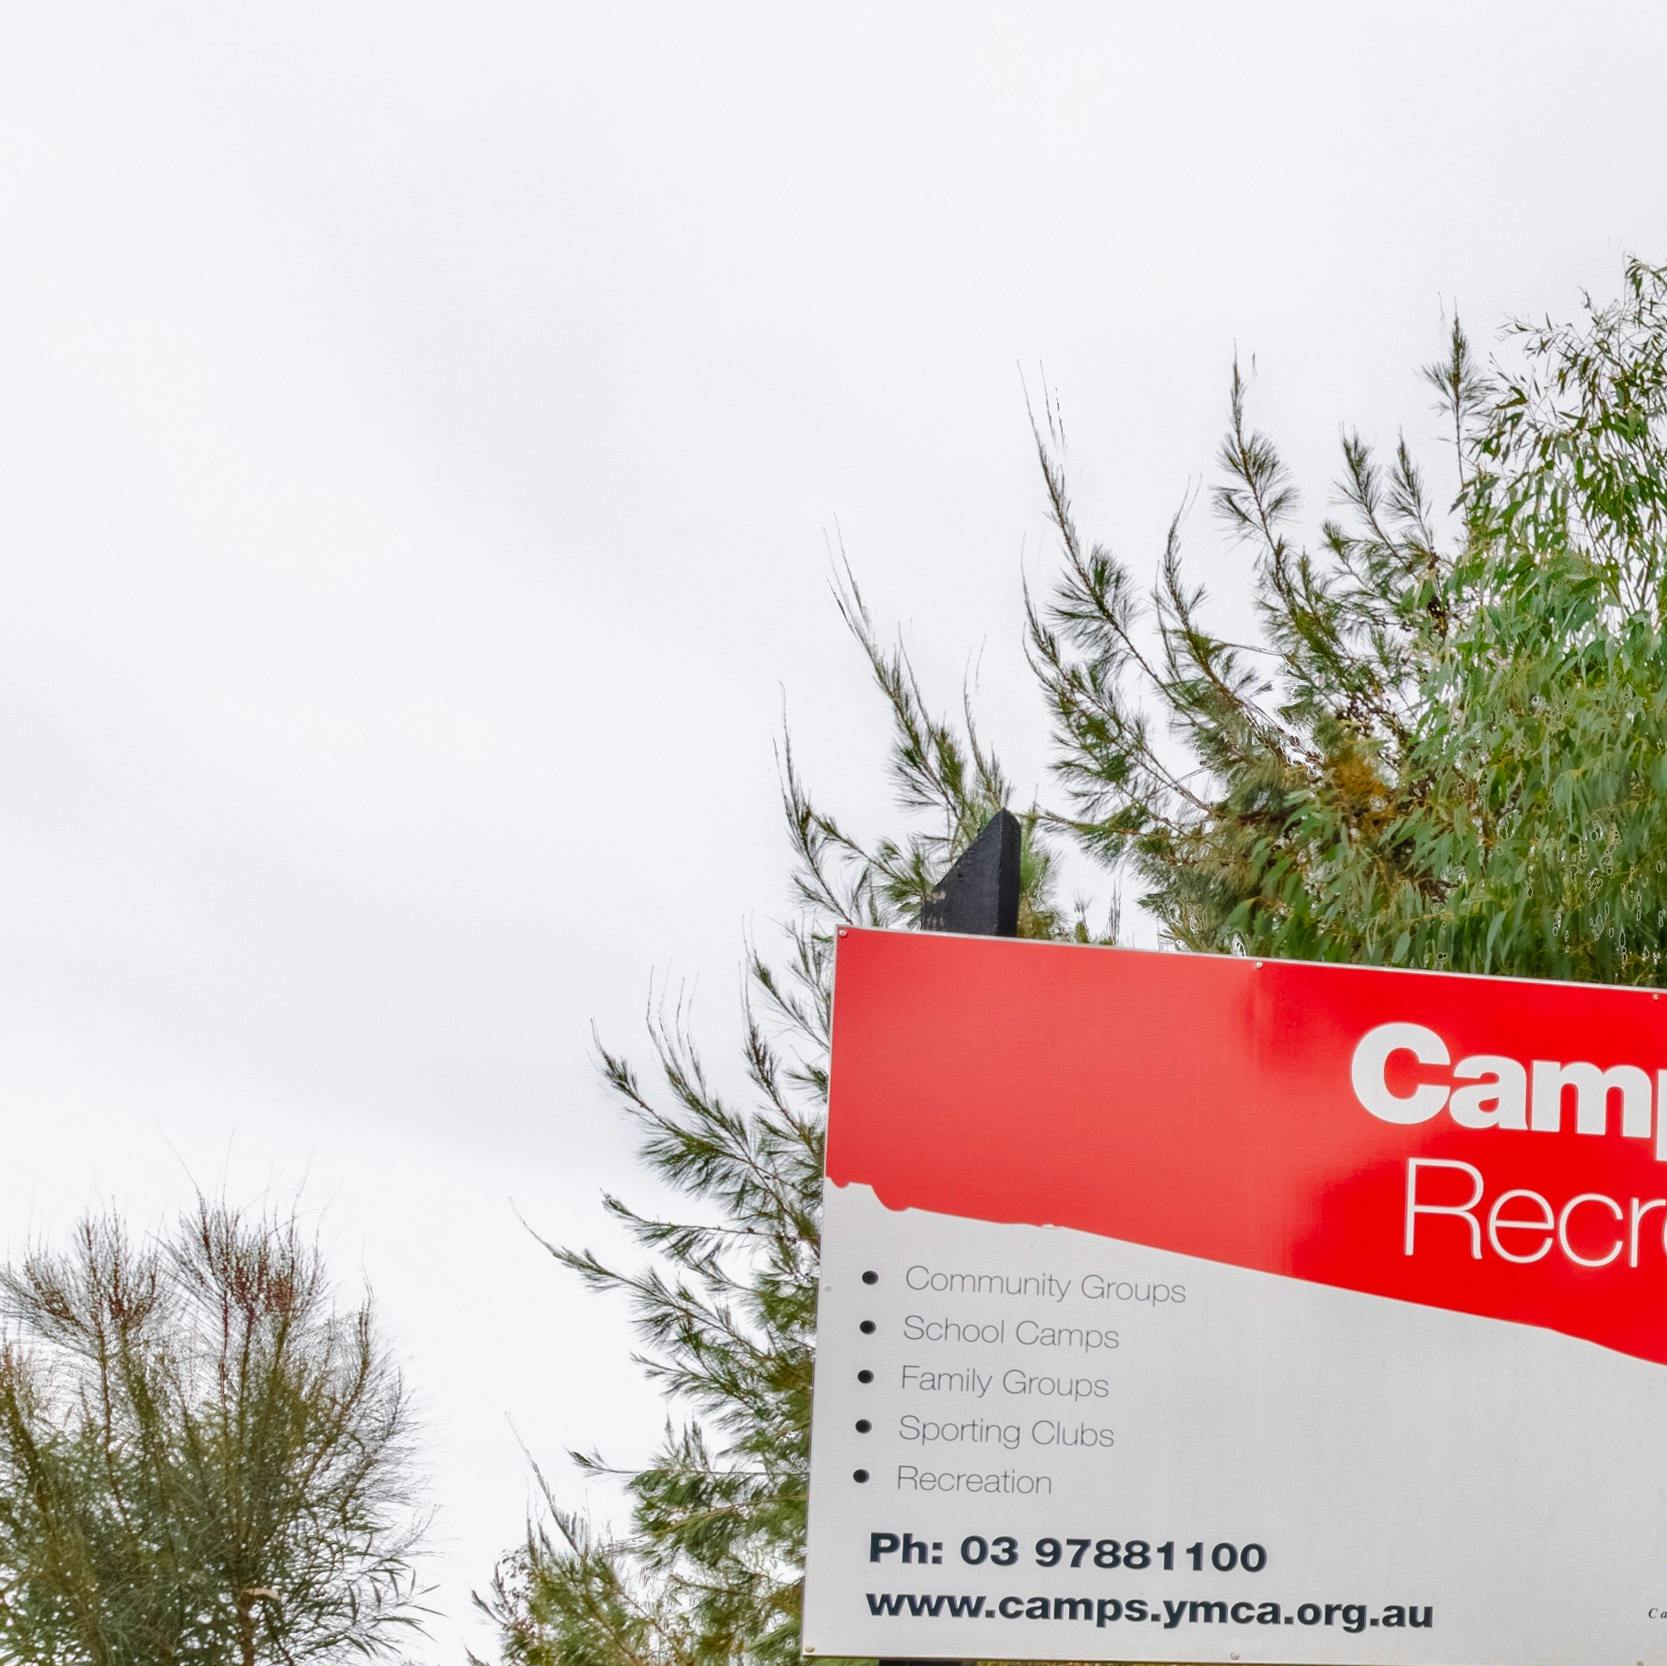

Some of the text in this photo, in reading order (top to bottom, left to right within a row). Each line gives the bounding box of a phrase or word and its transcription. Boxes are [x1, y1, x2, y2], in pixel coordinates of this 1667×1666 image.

[905, 1264, 1187, 1306] Community Groups
[903, 1315, 1120, 1352] School Camps
[900, 1365, 1110, 1401] Family Groups
[898, 1415, 1115, 1449] Sporting Clubs
[897, 1465, 1053, 1497] Recreation
[868, 1532, 1268, 1573] Ph: 03 97881100
[865, 1591, 1435, 1633] www.camps.ymca.org.au
